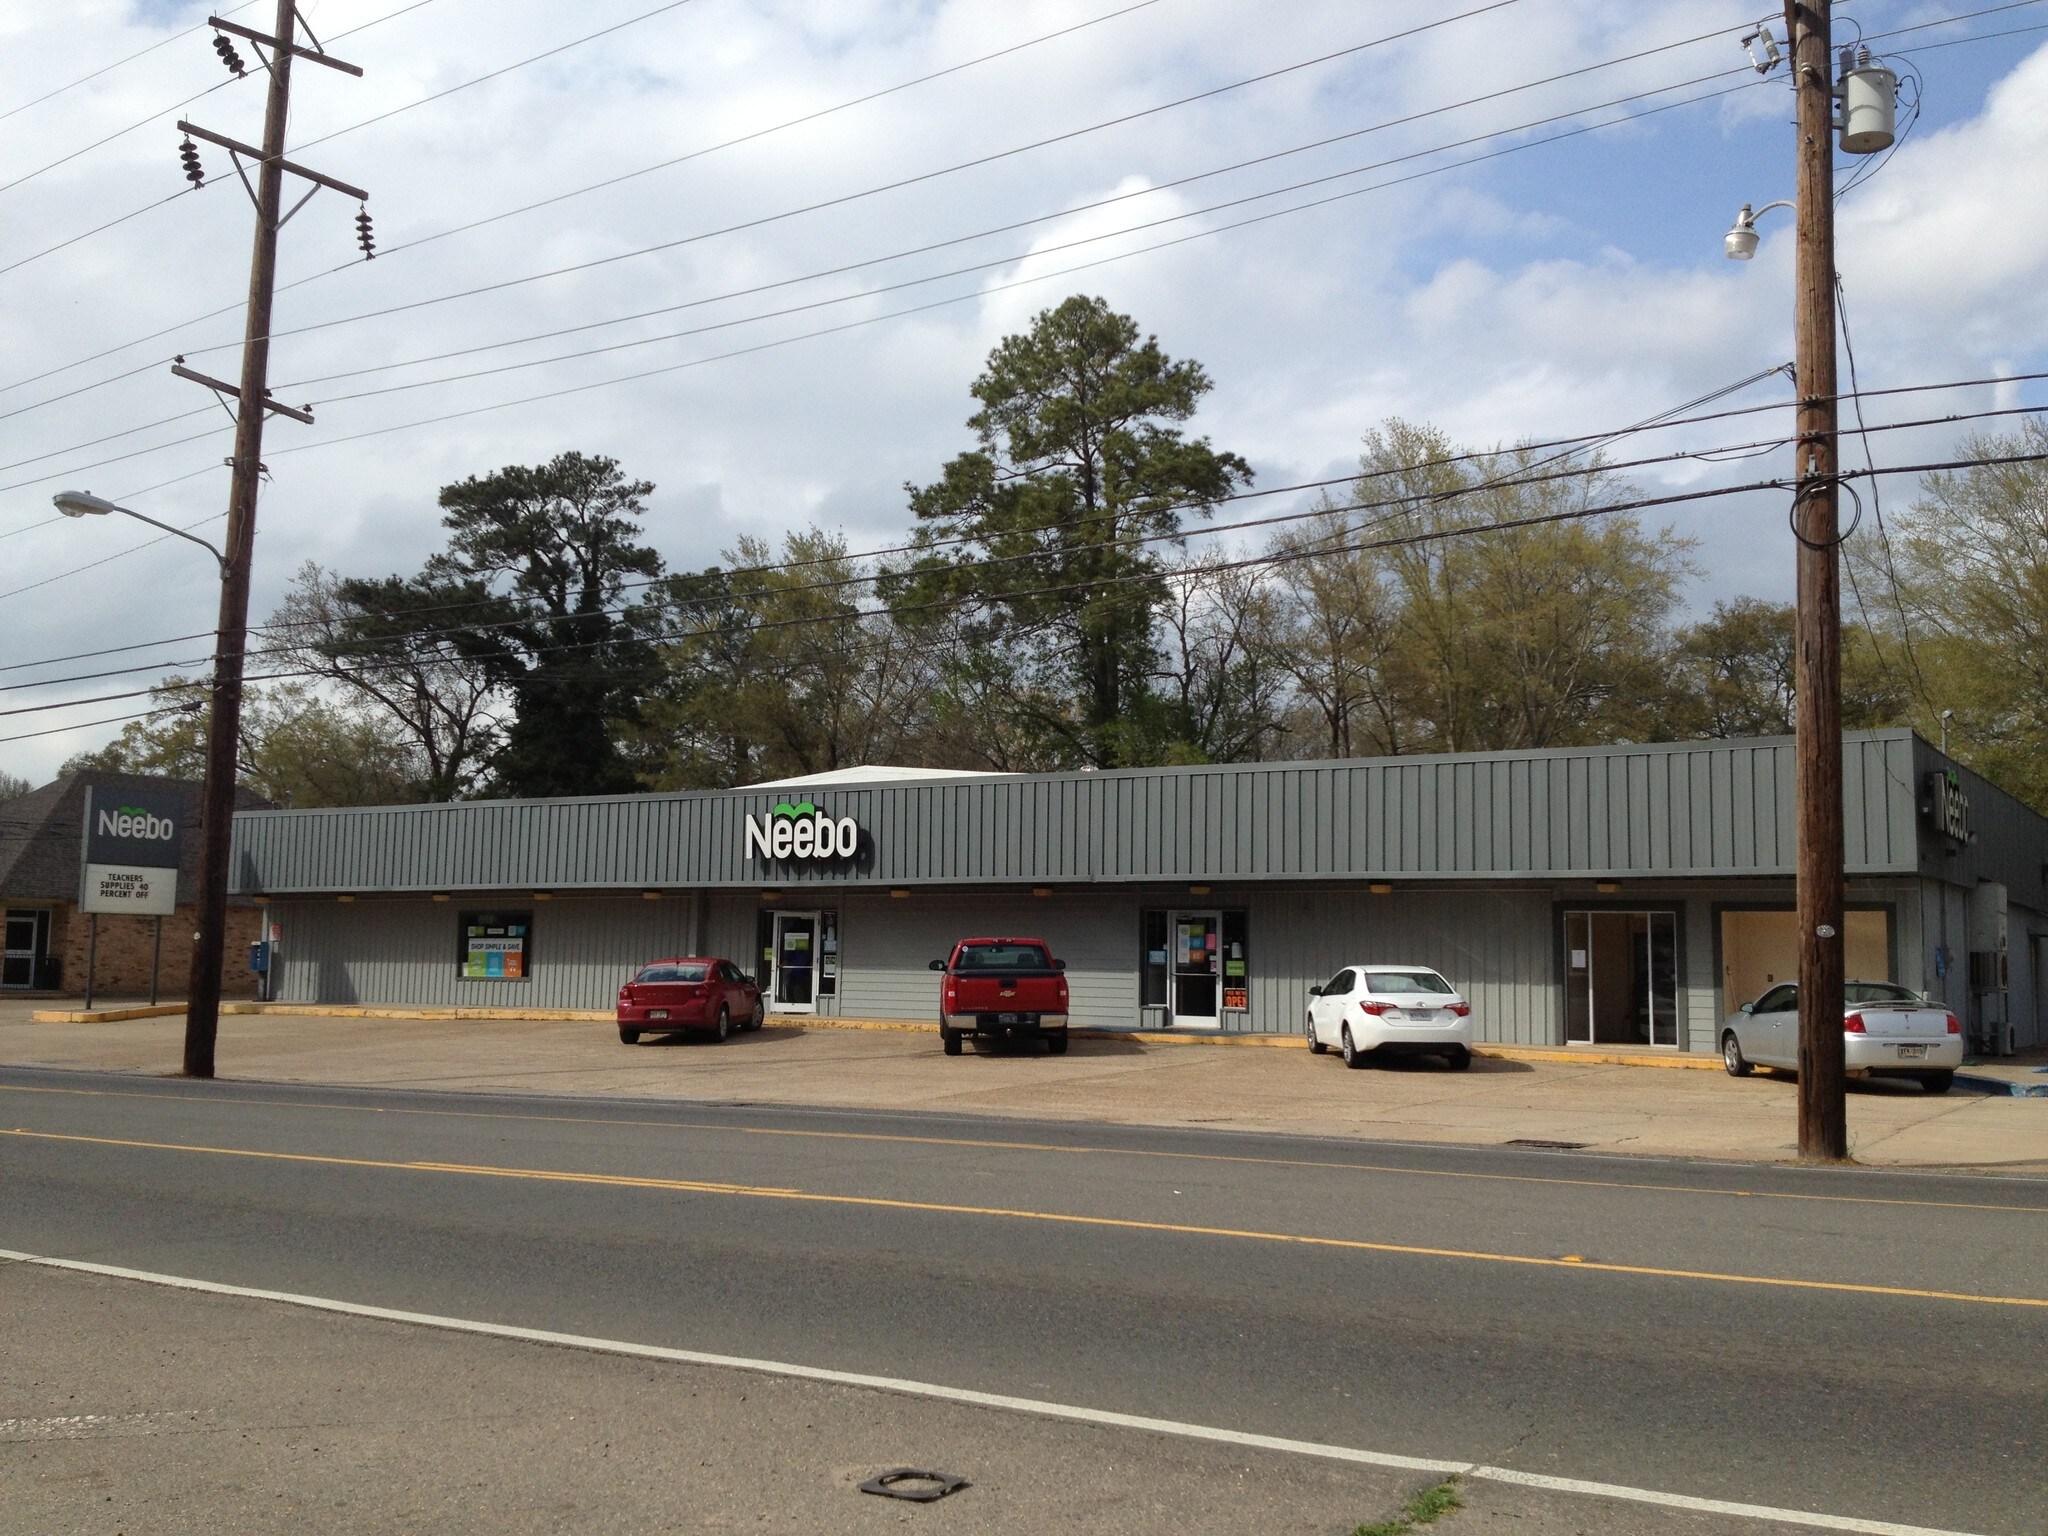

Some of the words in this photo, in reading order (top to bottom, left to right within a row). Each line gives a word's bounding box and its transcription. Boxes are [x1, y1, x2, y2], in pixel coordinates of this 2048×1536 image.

[1937, 772, 1969, 843] Neebo
[98, 808, 174, 841] Neebo
[745, 810, 857, 859] Neebo
[107, 873, 144, 883] TEACHERS
[100, 881, 135, 890] SUPPLIES
[138, 883, 149, 891] 40
[100, 889, 132, 898] PERCENT
[135, 891, 149, 899] OFF
[1226, 996, 1248, 1007] OPEN
